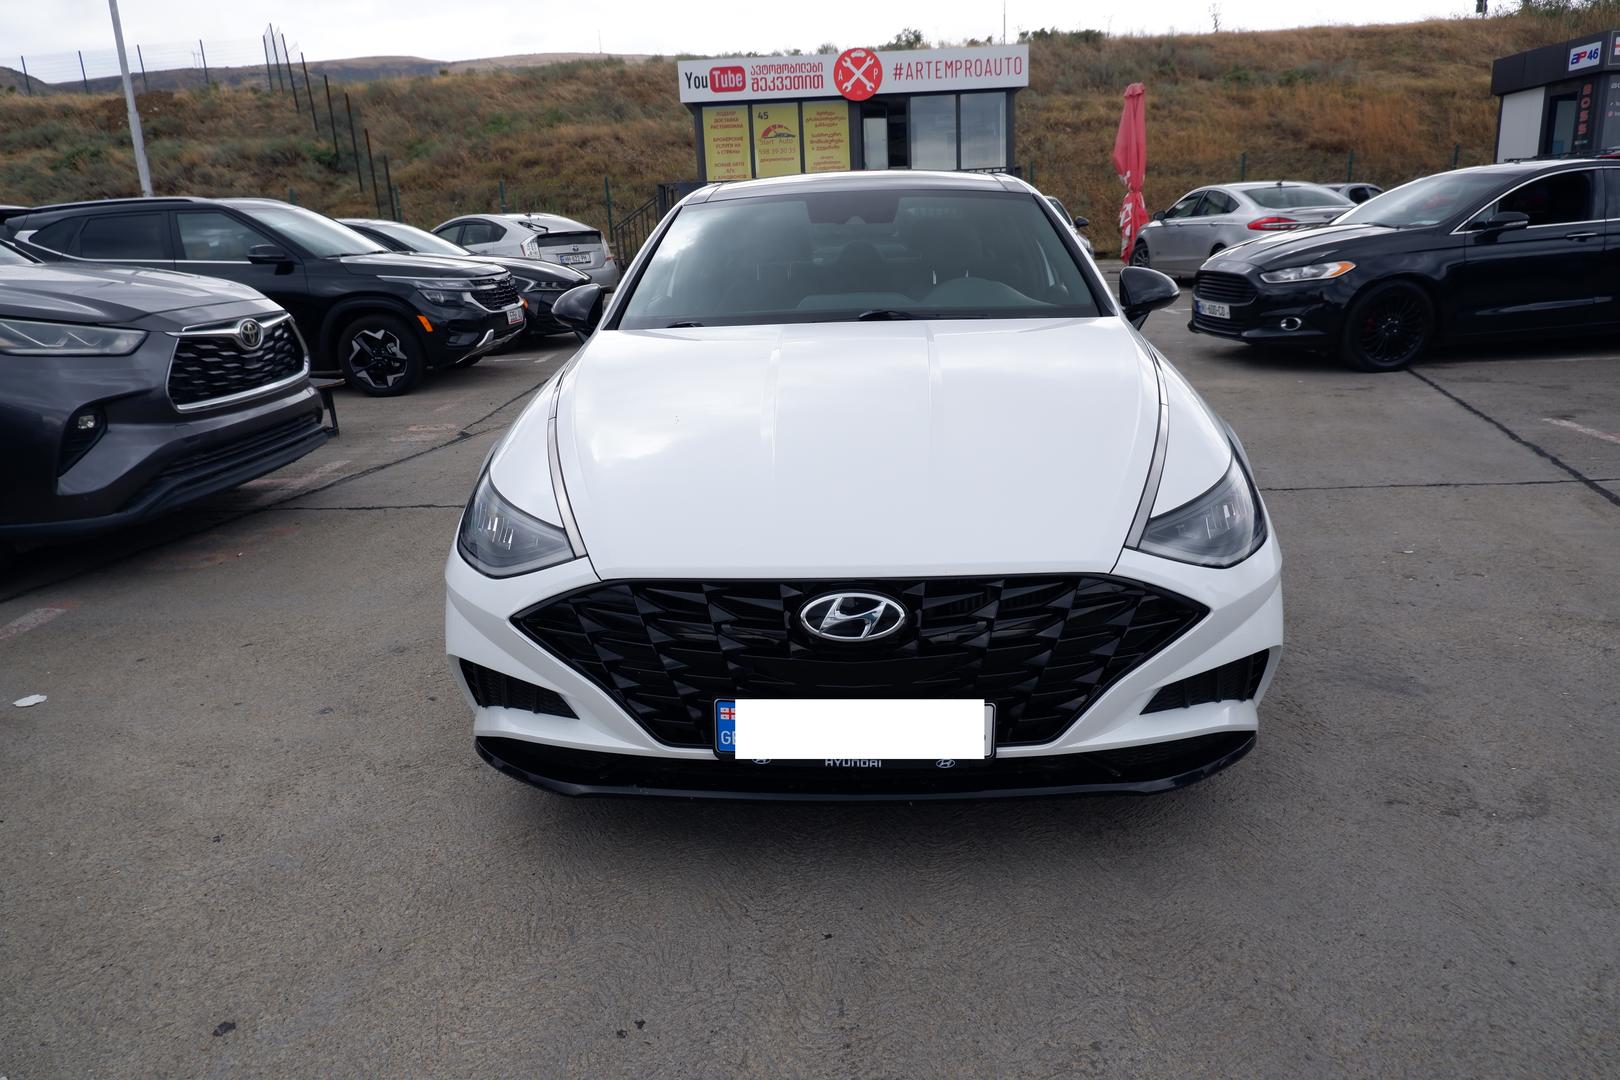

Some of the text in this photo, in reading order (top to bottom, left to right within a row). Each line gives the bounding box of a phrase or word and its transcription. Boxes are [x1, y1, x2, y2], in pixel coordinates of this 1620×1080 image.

[1587, 48, 1599, 60] 46
[893, 56, 1022, 81] #ARTEMPROAUTO
[758, 112, 768, 120] 45
[825, 759, 882, 768] HYUNDAI
